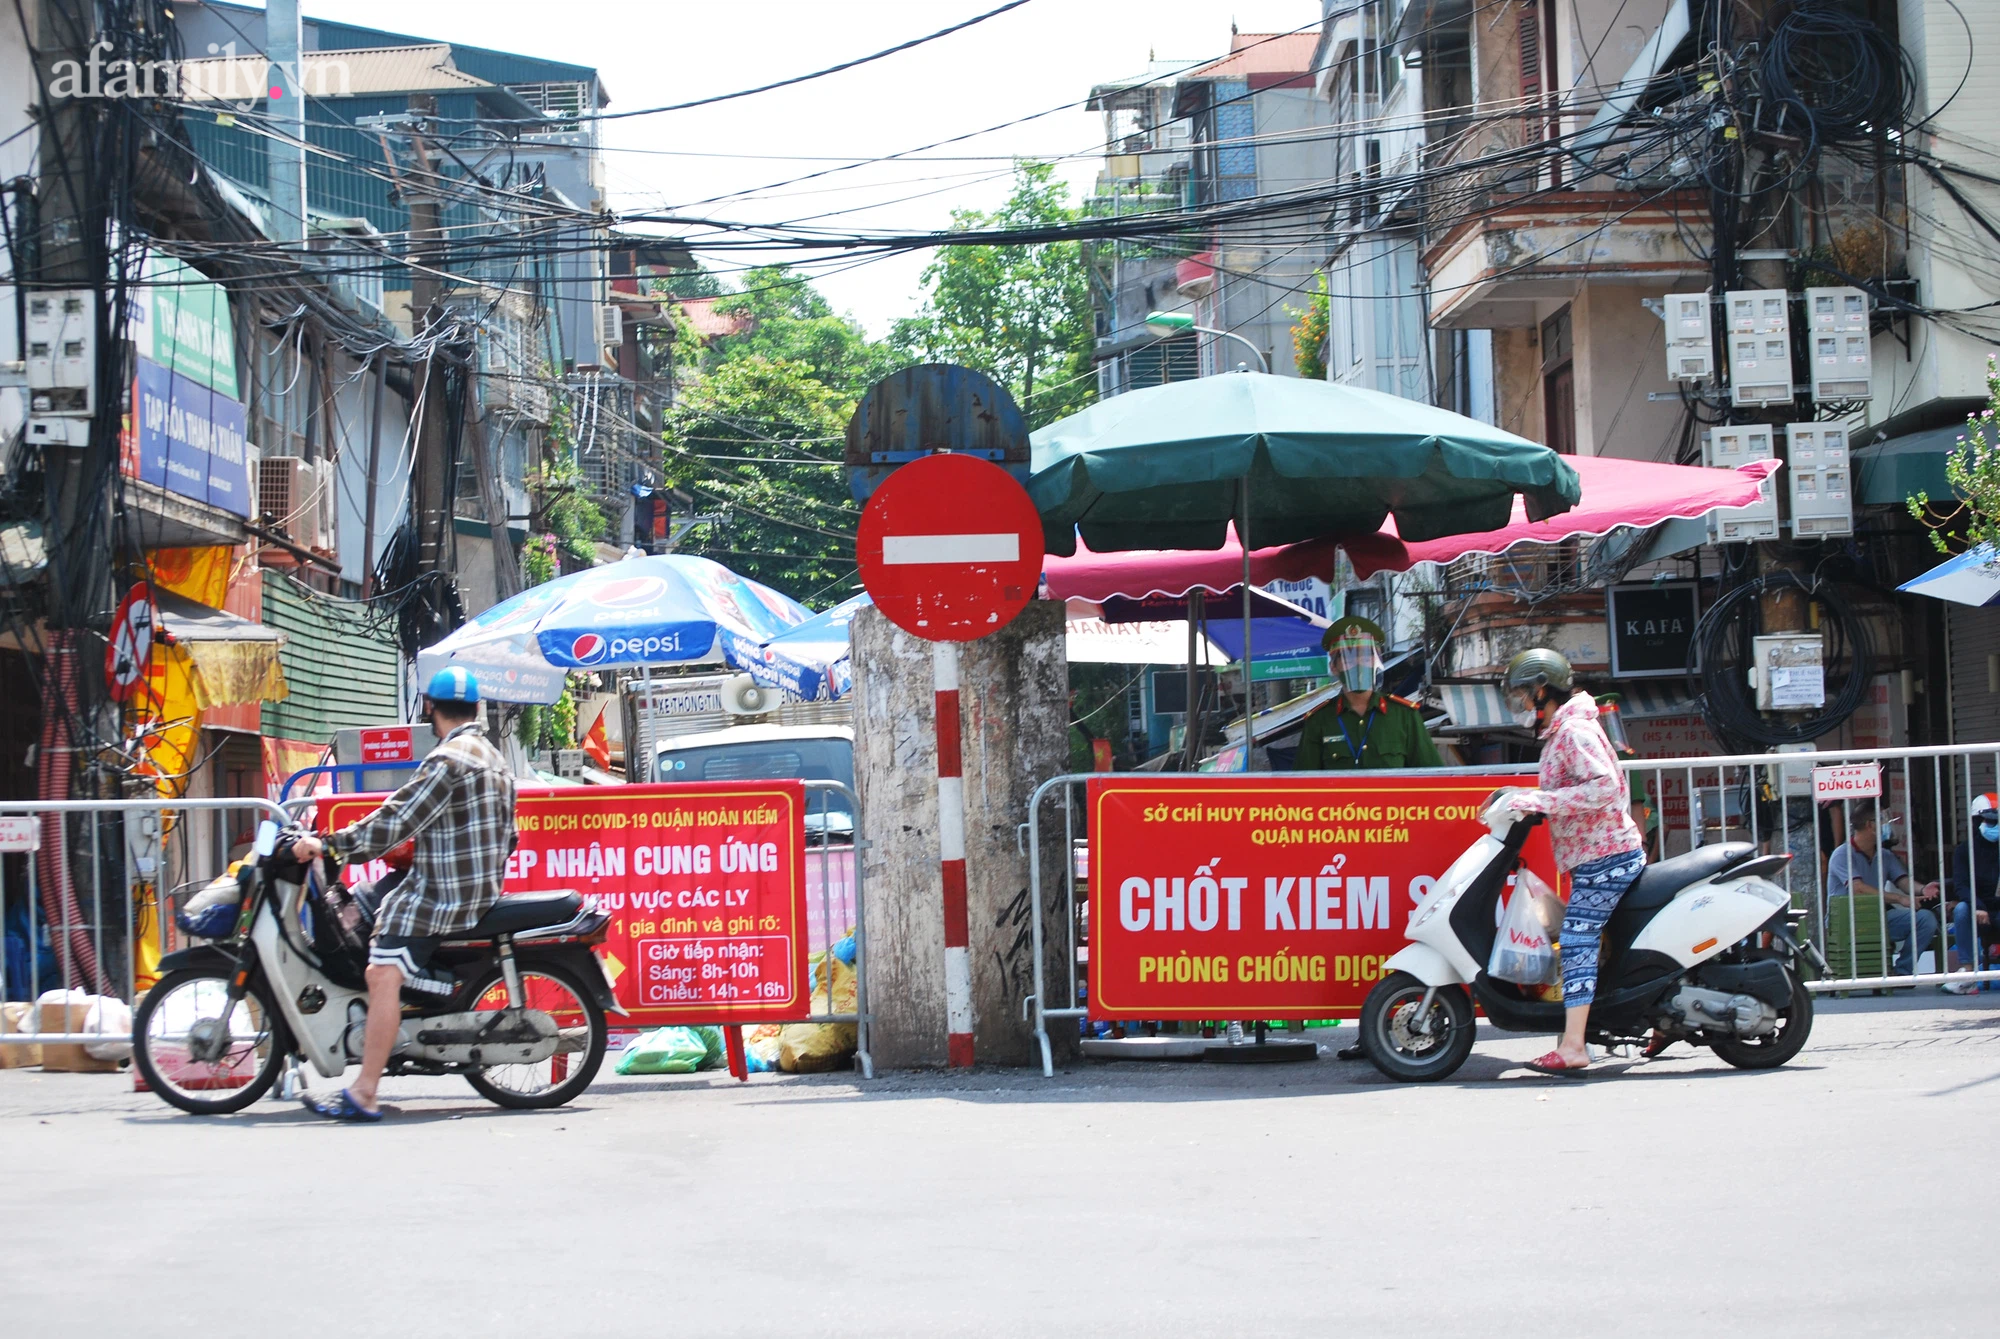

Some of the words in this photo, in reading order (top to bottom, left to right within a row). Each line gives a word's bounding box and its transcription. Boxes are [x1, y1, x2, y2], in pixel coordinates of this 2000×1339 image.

[1626, 618, 1684, 636] KAFA
[610, 632, 680, 659] pepsi
[1818, 778, 1853, 791] DỪNG
[1855, 779, 1876, 790] LẠI
[543, 815, 578, 835] DỊCH
[582, 812, 648, 830] COVID-19
[651, 807, 694, 832] QUẬN
[697, 806, 739, 827] HOÀN
[743, 802, 778, 826] KIẾM
[1143, 802, 1169, 822] SỞ
[1172, 802, 1203, 822] CHỈ
[1207, 806, 1245, 822] HUY
[1249, 803, 1314, 822] PHÒNG
[1317, 802, 1382, 821] CHỐNG
[1386, 806, 1429, 825] DỊCH
[1251, 826, 1304, 848] QUẬN
[1308, 826, 1360, 844] HOÀN
[1364, 823, 1409, 843] KIẾM
[546, 841, 625, 883] NHẬN
[634, 844, 711, 876] CUNG
[720, 835, 778, 874] ỨNG
[630, 890, 673, 914] VỰC
[678, 885, 721, 908] CÁC
[725, 888, 750, 907] LY
[1118, 857, 1248, 932] CHỐT
[1263, 852, 1391, 931] KIỂM
[630, 917, 656, 939] gia
[660, 916, 697, 934] đình
[702, 917, 723, 933] và
[728, 915, 754, 936] ghi
[758, 915, 781, 931] rõ:
[648, 944, 680, 961] Giờ
[683, 940, 714, 961] tiếp
[718, 943, 764, 961] nhận:
[650, 964, 697, 982] Sáng:
[701, 961, 760, 979] 8h-10h
[1139, 949, 1229, 984] PHÒNG
[1237, 945, 1331, 984] CHỐNG
[650, 983, 702, 1001] Chiều:
[708, 984, 739, 999] 14h
[754, 981, 785, 998] 16h
